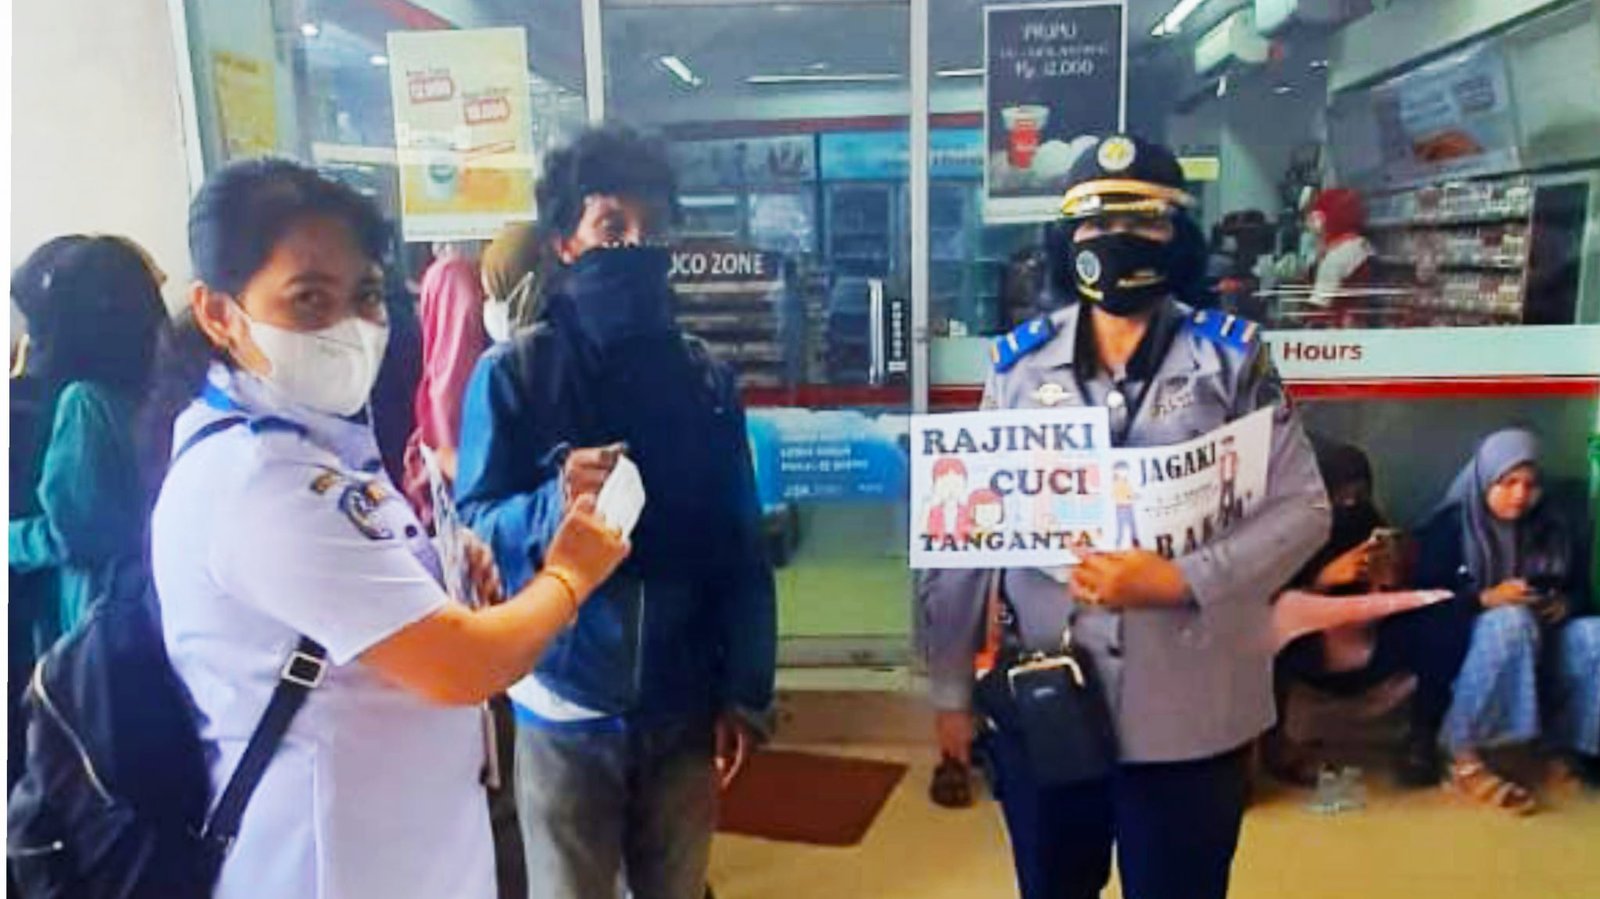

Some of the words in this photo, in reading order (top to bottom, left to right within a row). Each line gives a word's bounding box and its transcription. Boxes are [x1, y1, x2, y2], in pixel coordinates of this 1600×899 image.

[711, 252, 764, 275] ZONE
[1282, 341, 1363, 360] Hours
[921, 422, 1096, 456] RAJINKI
[990, 468, 1090, 496] CUCI
